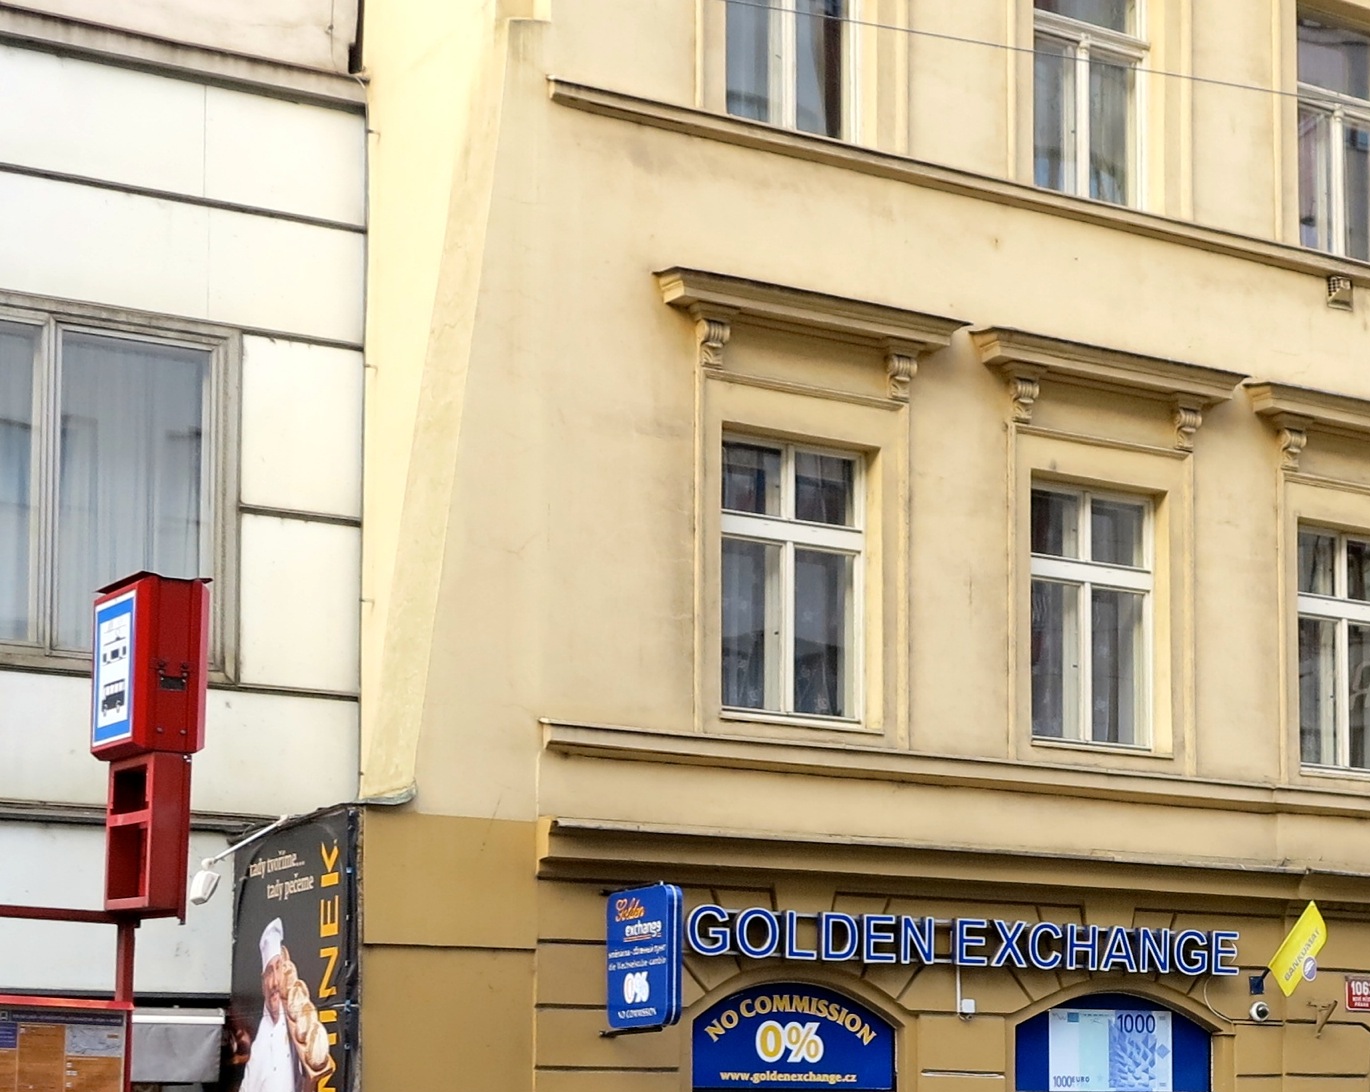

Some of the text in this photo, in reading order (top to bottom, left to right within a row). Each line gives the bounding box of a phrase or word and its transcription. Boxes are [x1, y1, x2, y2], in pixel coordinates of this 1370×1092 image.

[249, 858, 266, 879] tady
[267, 873, 314, 900] tady pečeme
[615, 897, 645, 922] Golden
[624, 919, 662, 938] exchange
[687, 904, 1240, 976] GOLDEN EXCHANGE
[623, 970, 650, 1004] 0%
[703, 994, 878, 1046] NO COMMISSION
[1117, 1014, 1156, 1034] 1000
[755, 1020, 825, 1064] 0%
[720, 1070, 858, 1084] www.goldenexchange.cz
[1053, 1076, 1072, 1088] 1000
